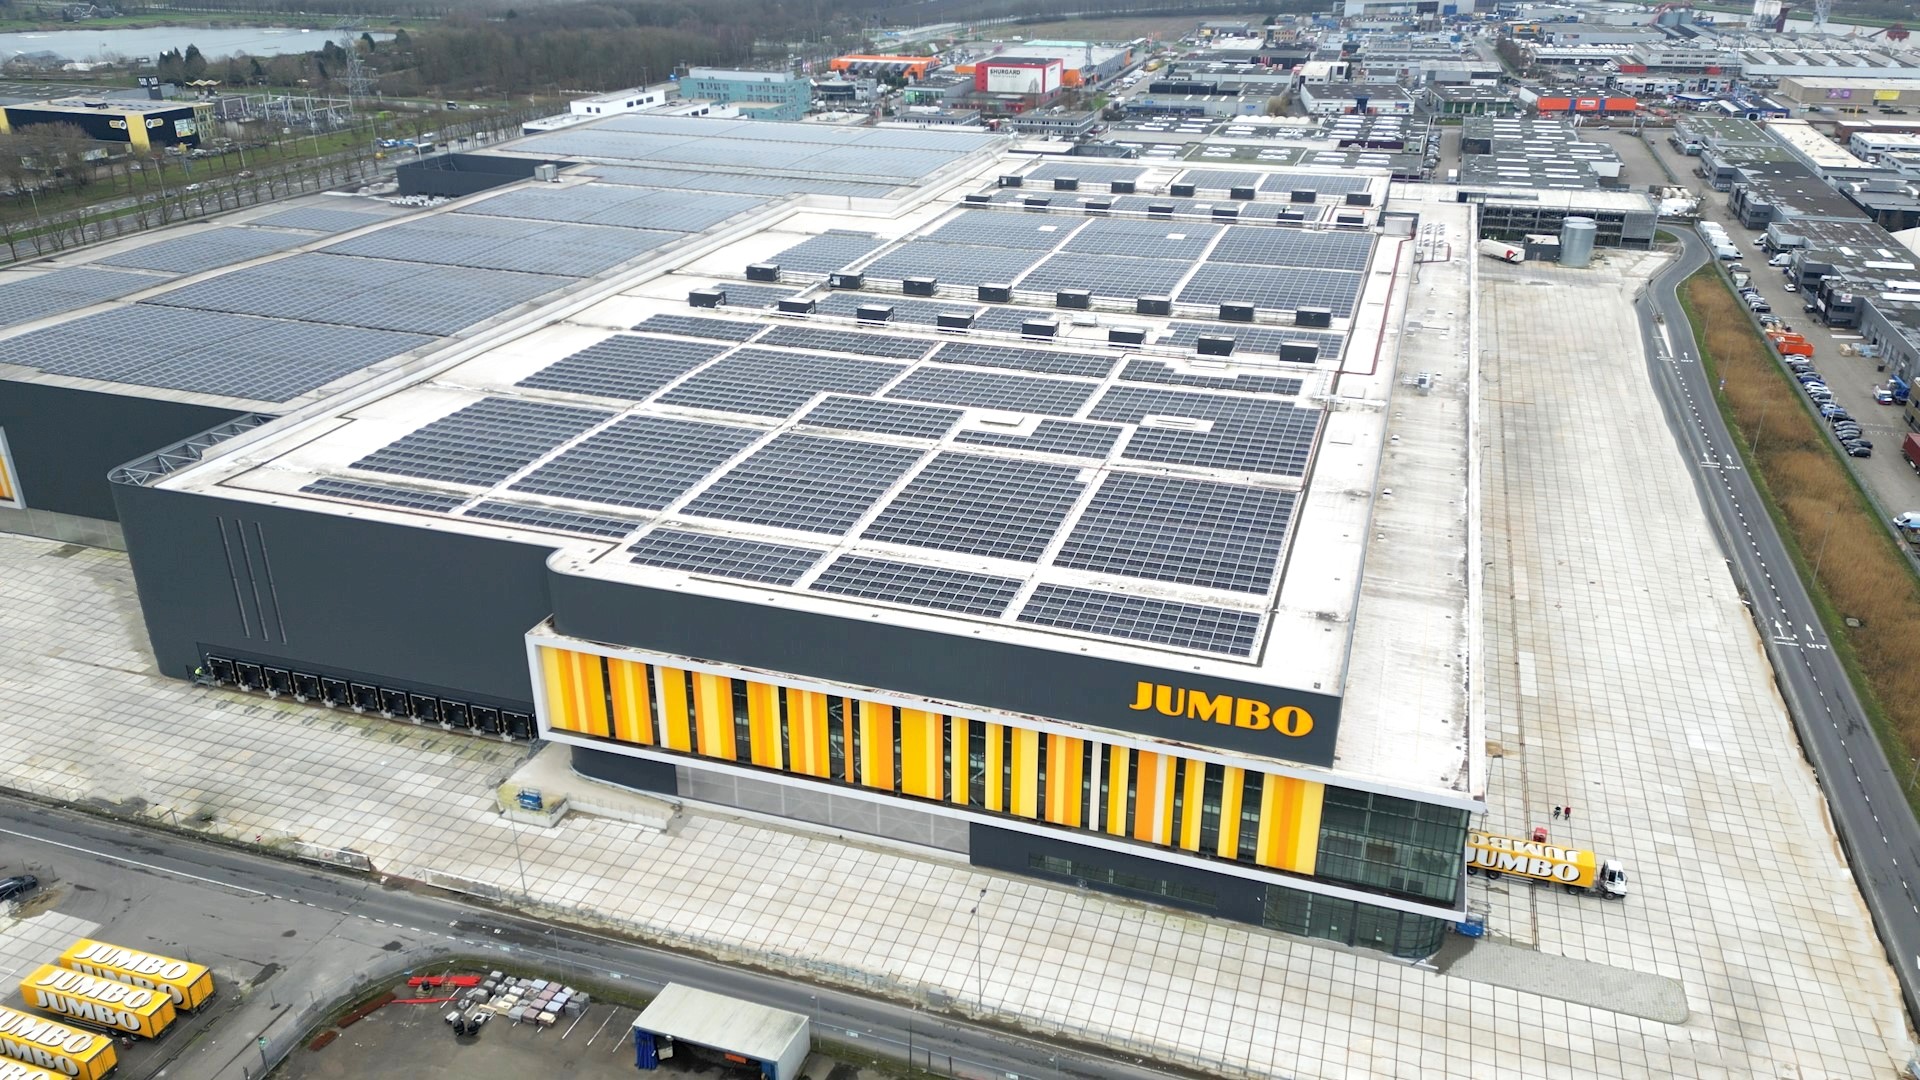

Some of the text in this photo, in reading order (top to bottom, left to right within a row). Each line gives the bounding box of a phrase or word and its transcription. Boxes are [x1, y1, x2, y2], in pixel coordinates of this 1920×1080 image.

[1129, 681, 1314, 737] JUMBO
[1467, 834, 1580, 862] JUMBO
[74, 943, 188, 979] JUMBO
[36, 968, 152, 1008] JUMBO
[36, 989, 141, 1031] JUMBO
[0, 1008, 93, 1053] UMBO
[0, 1037, 79, 1076] MBO
